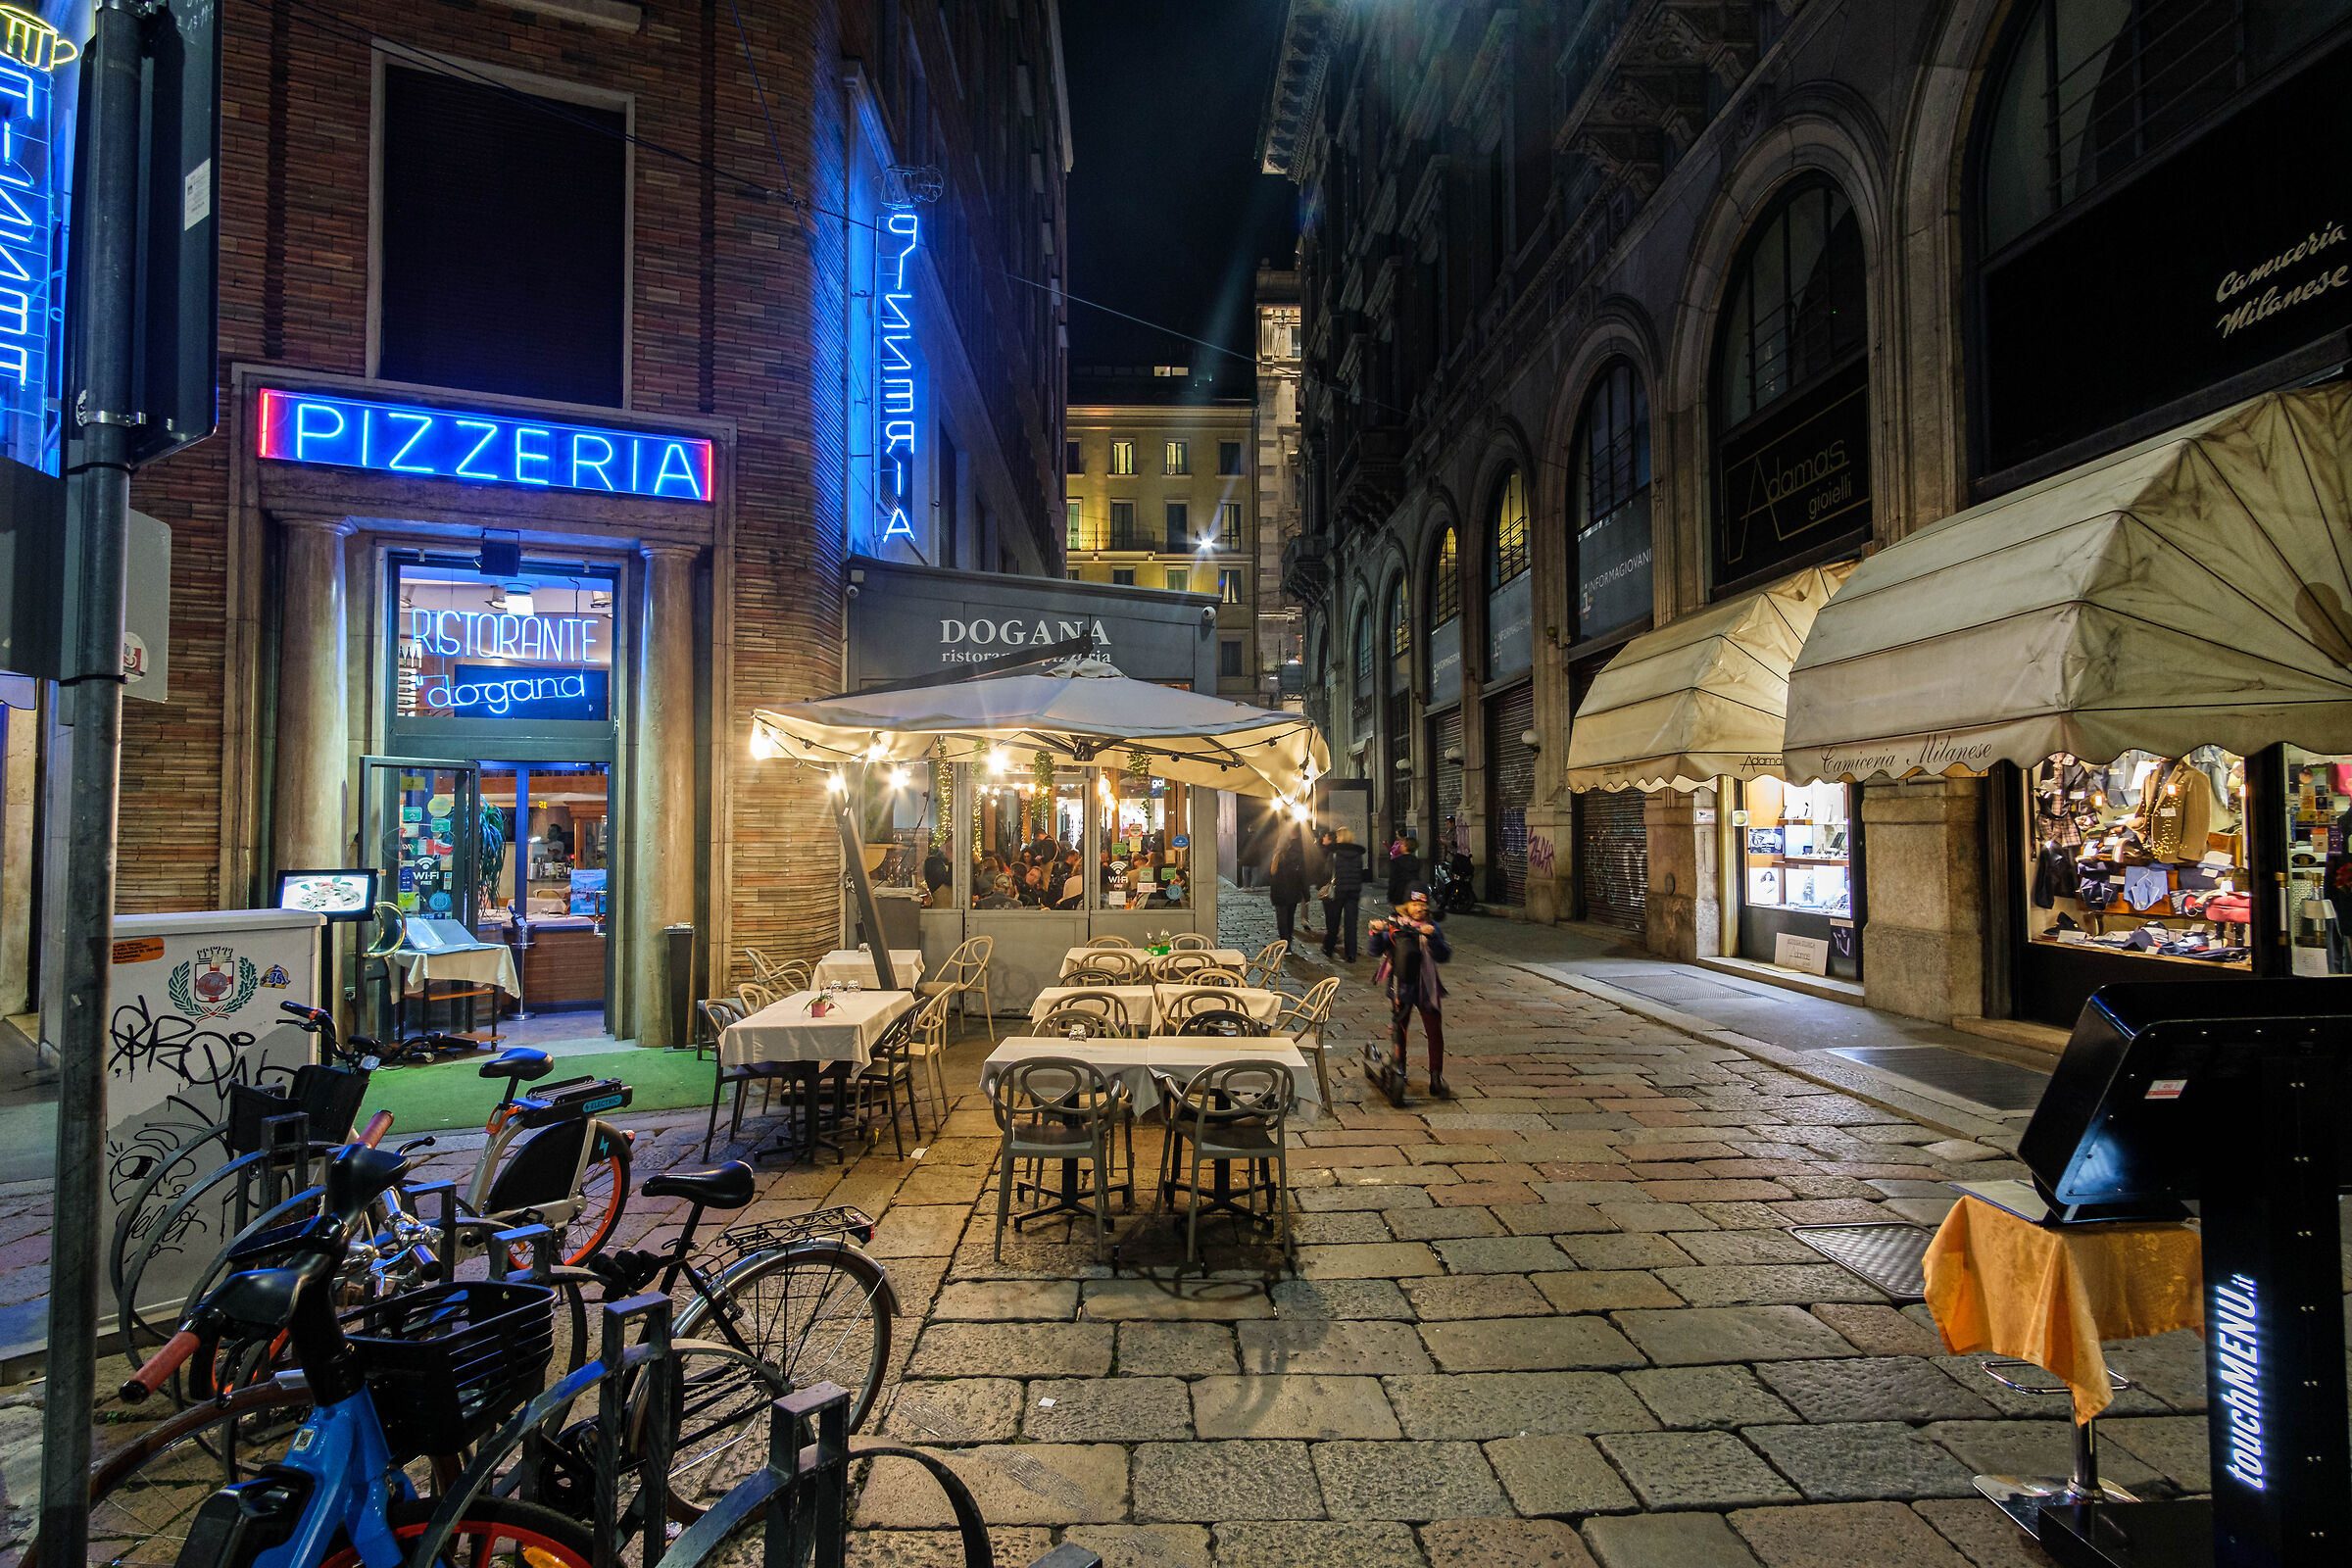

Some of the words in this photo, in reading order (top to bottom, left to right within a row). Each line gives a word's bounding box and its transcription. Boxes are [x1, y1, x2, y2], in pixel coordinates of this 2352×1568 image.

[2216, 220, 2346, 303] Camiceria
[2216, 265, 2349, 338] Milanese
[296, 403, 701, 498] PIZZERIA
[1740, 440, 1850, 558] Adamas
[1808, 471, 1851, 520] gioielli
[1588, 548, 1652, 595] INFORMAGIOVANI
[412, 608, 601, 662] RISTORANTE
[940, 618, 1111, 646] DOGANA
[1739, 755, 1784, 773] Adama
[1820, 745, 1897, 774] Camiceria
[1906, 733, 1992, 765] Milanese
[591, 1096, 619, 1109] ELECTRIC
[2216, 1272, 2265, 1491] touchMENU.it
